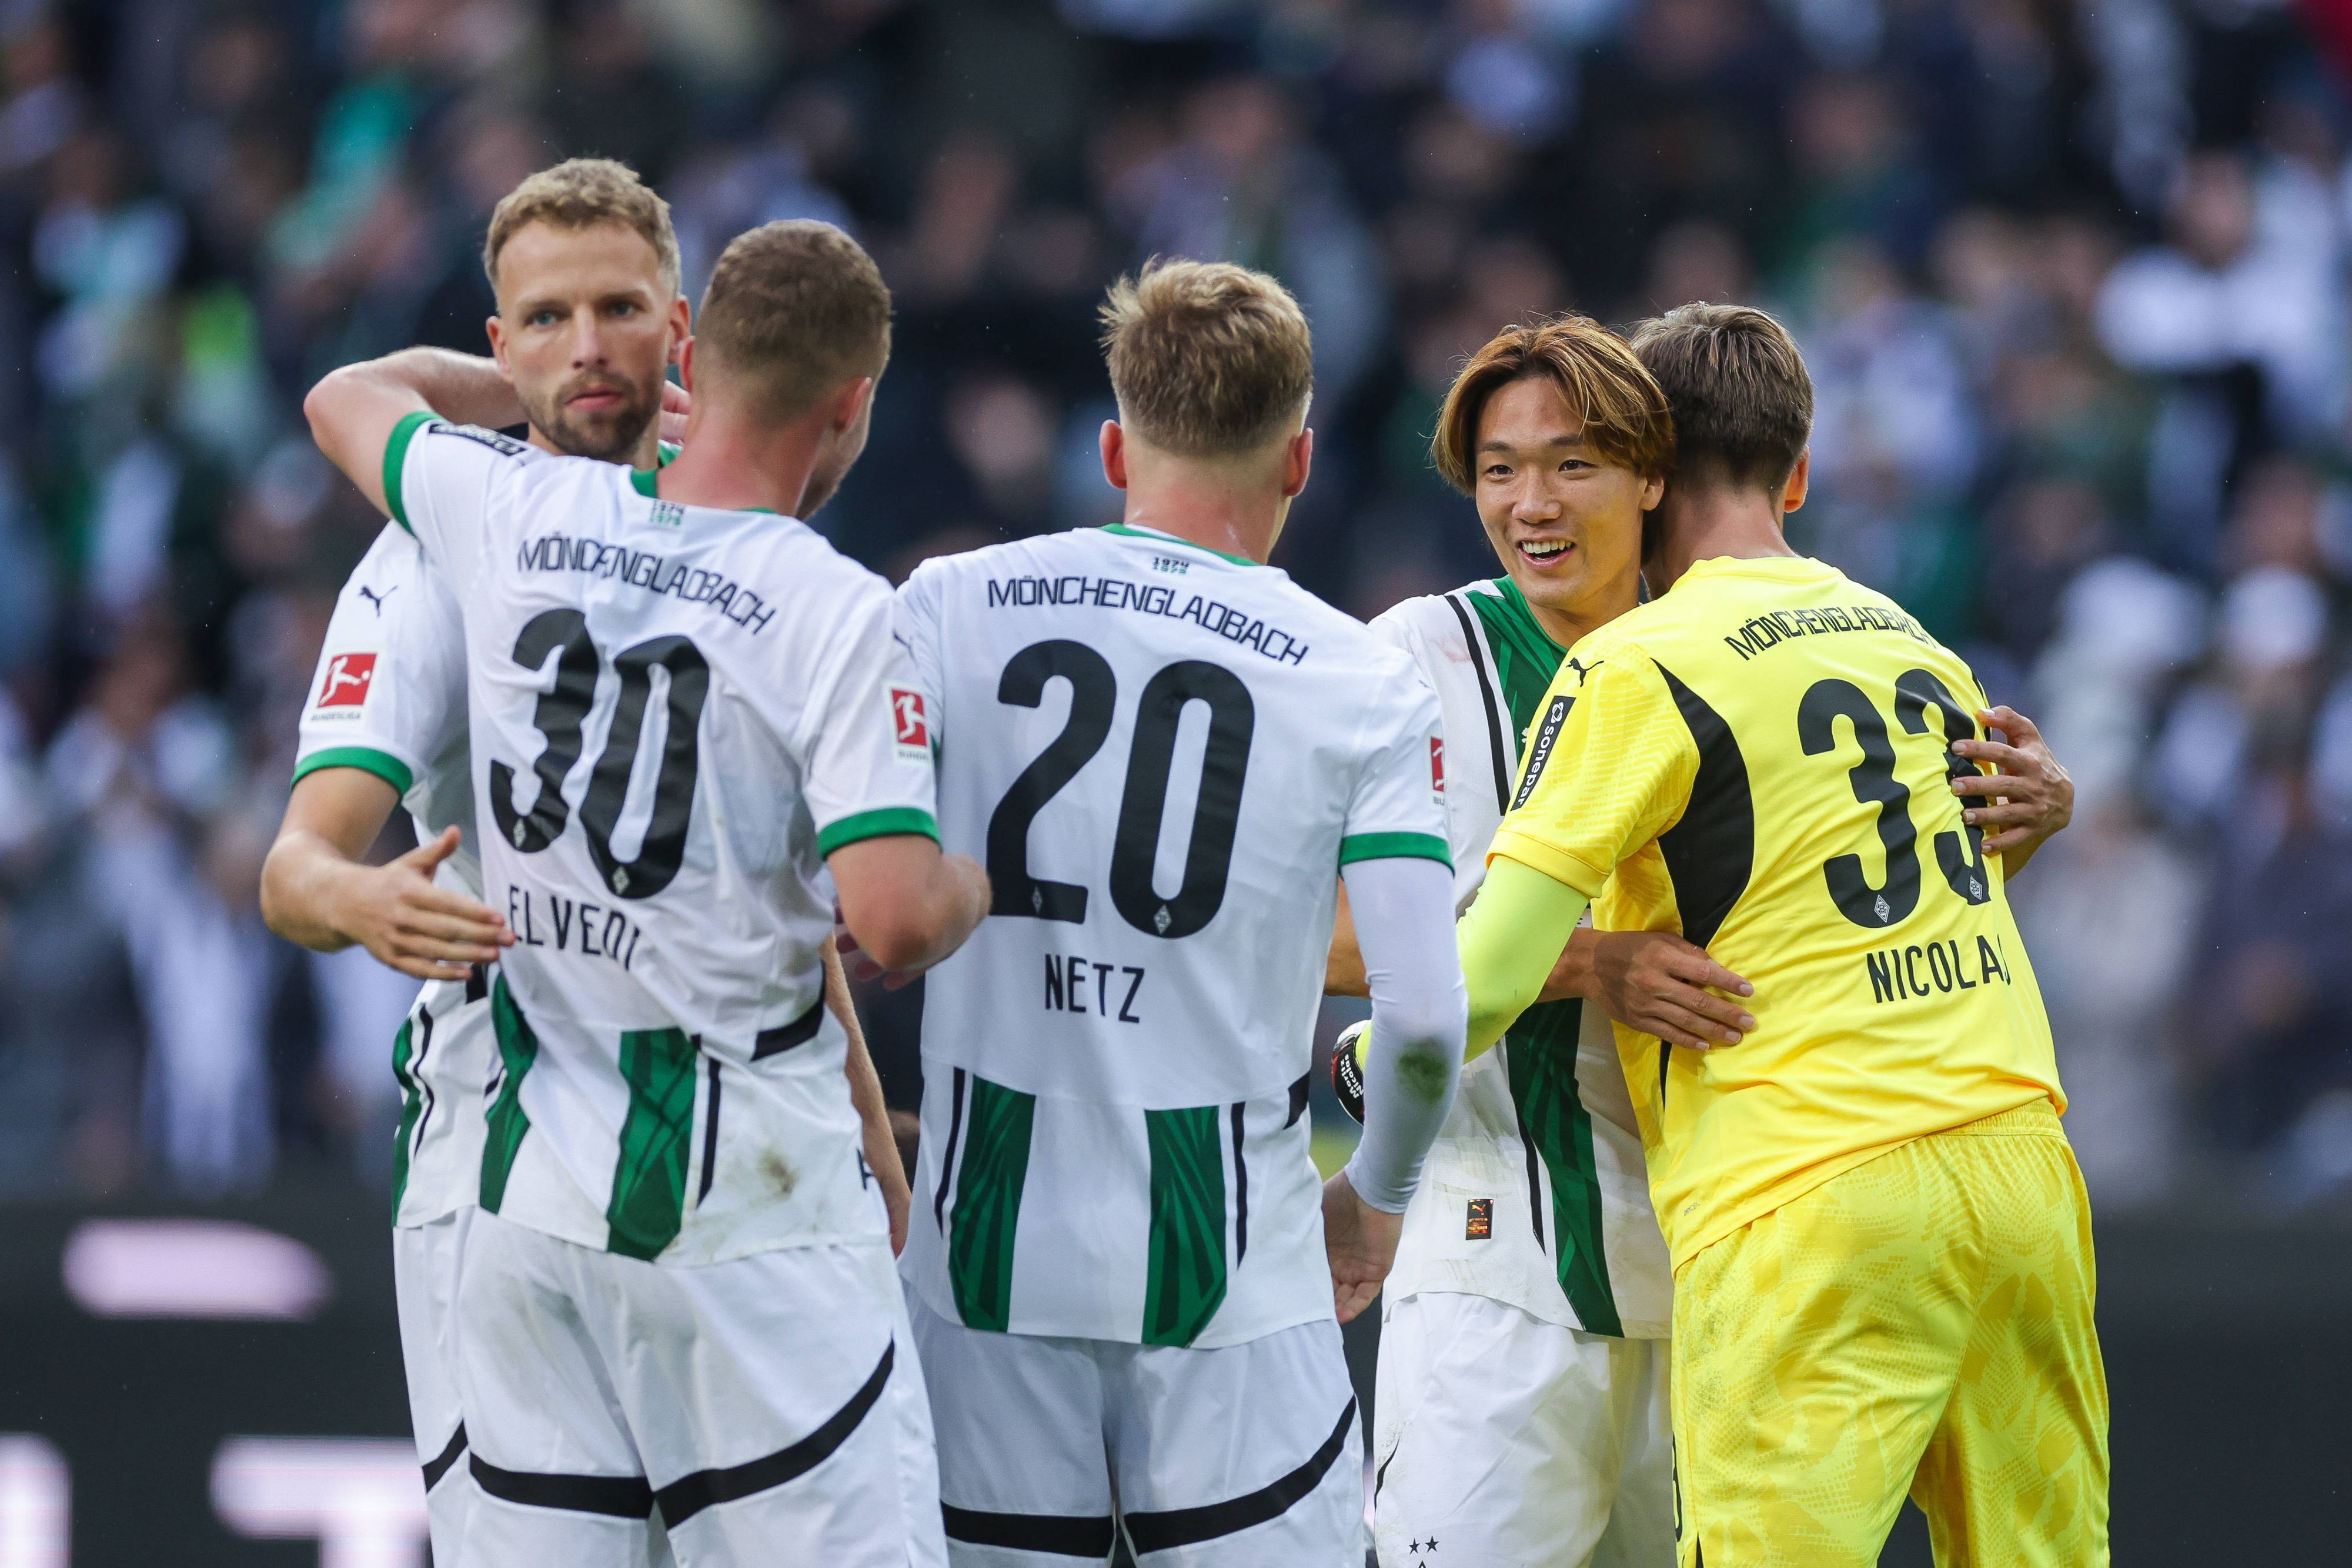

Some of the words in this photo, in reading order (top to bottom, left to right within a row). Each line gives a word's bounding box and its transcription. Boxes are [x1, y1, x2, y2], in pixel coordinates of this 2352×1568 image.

[517, 530, 776, 635] MÖNCENGLADBACH
[987, 574, 1309, 666] MÖNCHENGLADBACH
[490, 608, 710, 900] 30
[985, 638, 1255, 940] 20
[1518, 726, 1554, 805] sonepar
[1797, 668, 1992, 928] 33
[1044, 953, 1145, 1024] NETZ
[1340, 1059, 1359, 1099] Moritz
[1344, 1054, 1364, 1095] Nicolas
